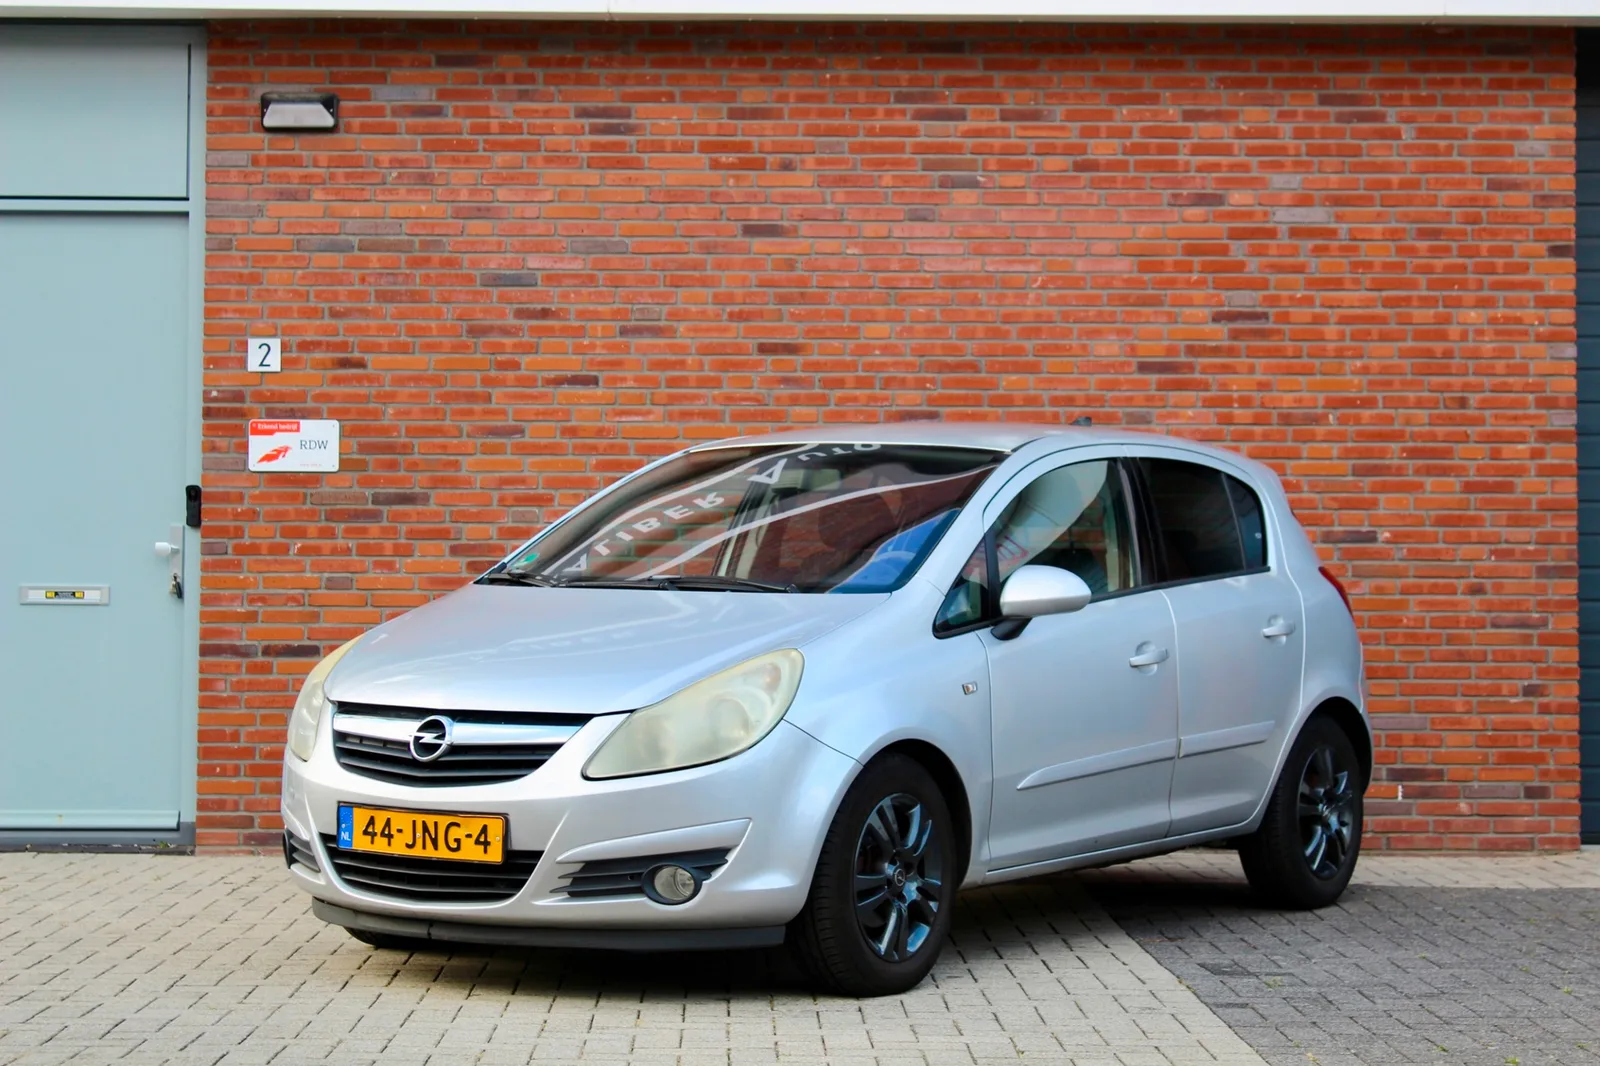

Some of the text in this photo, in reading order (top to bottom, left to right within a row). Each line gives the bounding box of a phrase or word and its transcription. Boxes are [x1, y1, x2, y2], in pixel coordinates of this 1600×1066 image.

[258, 343, 271, 367] 2
[299, 439, 329, 451] RDW
[340, 831, 352, 841] NL
[362, 815, 491, 854] 44-JNG-4
